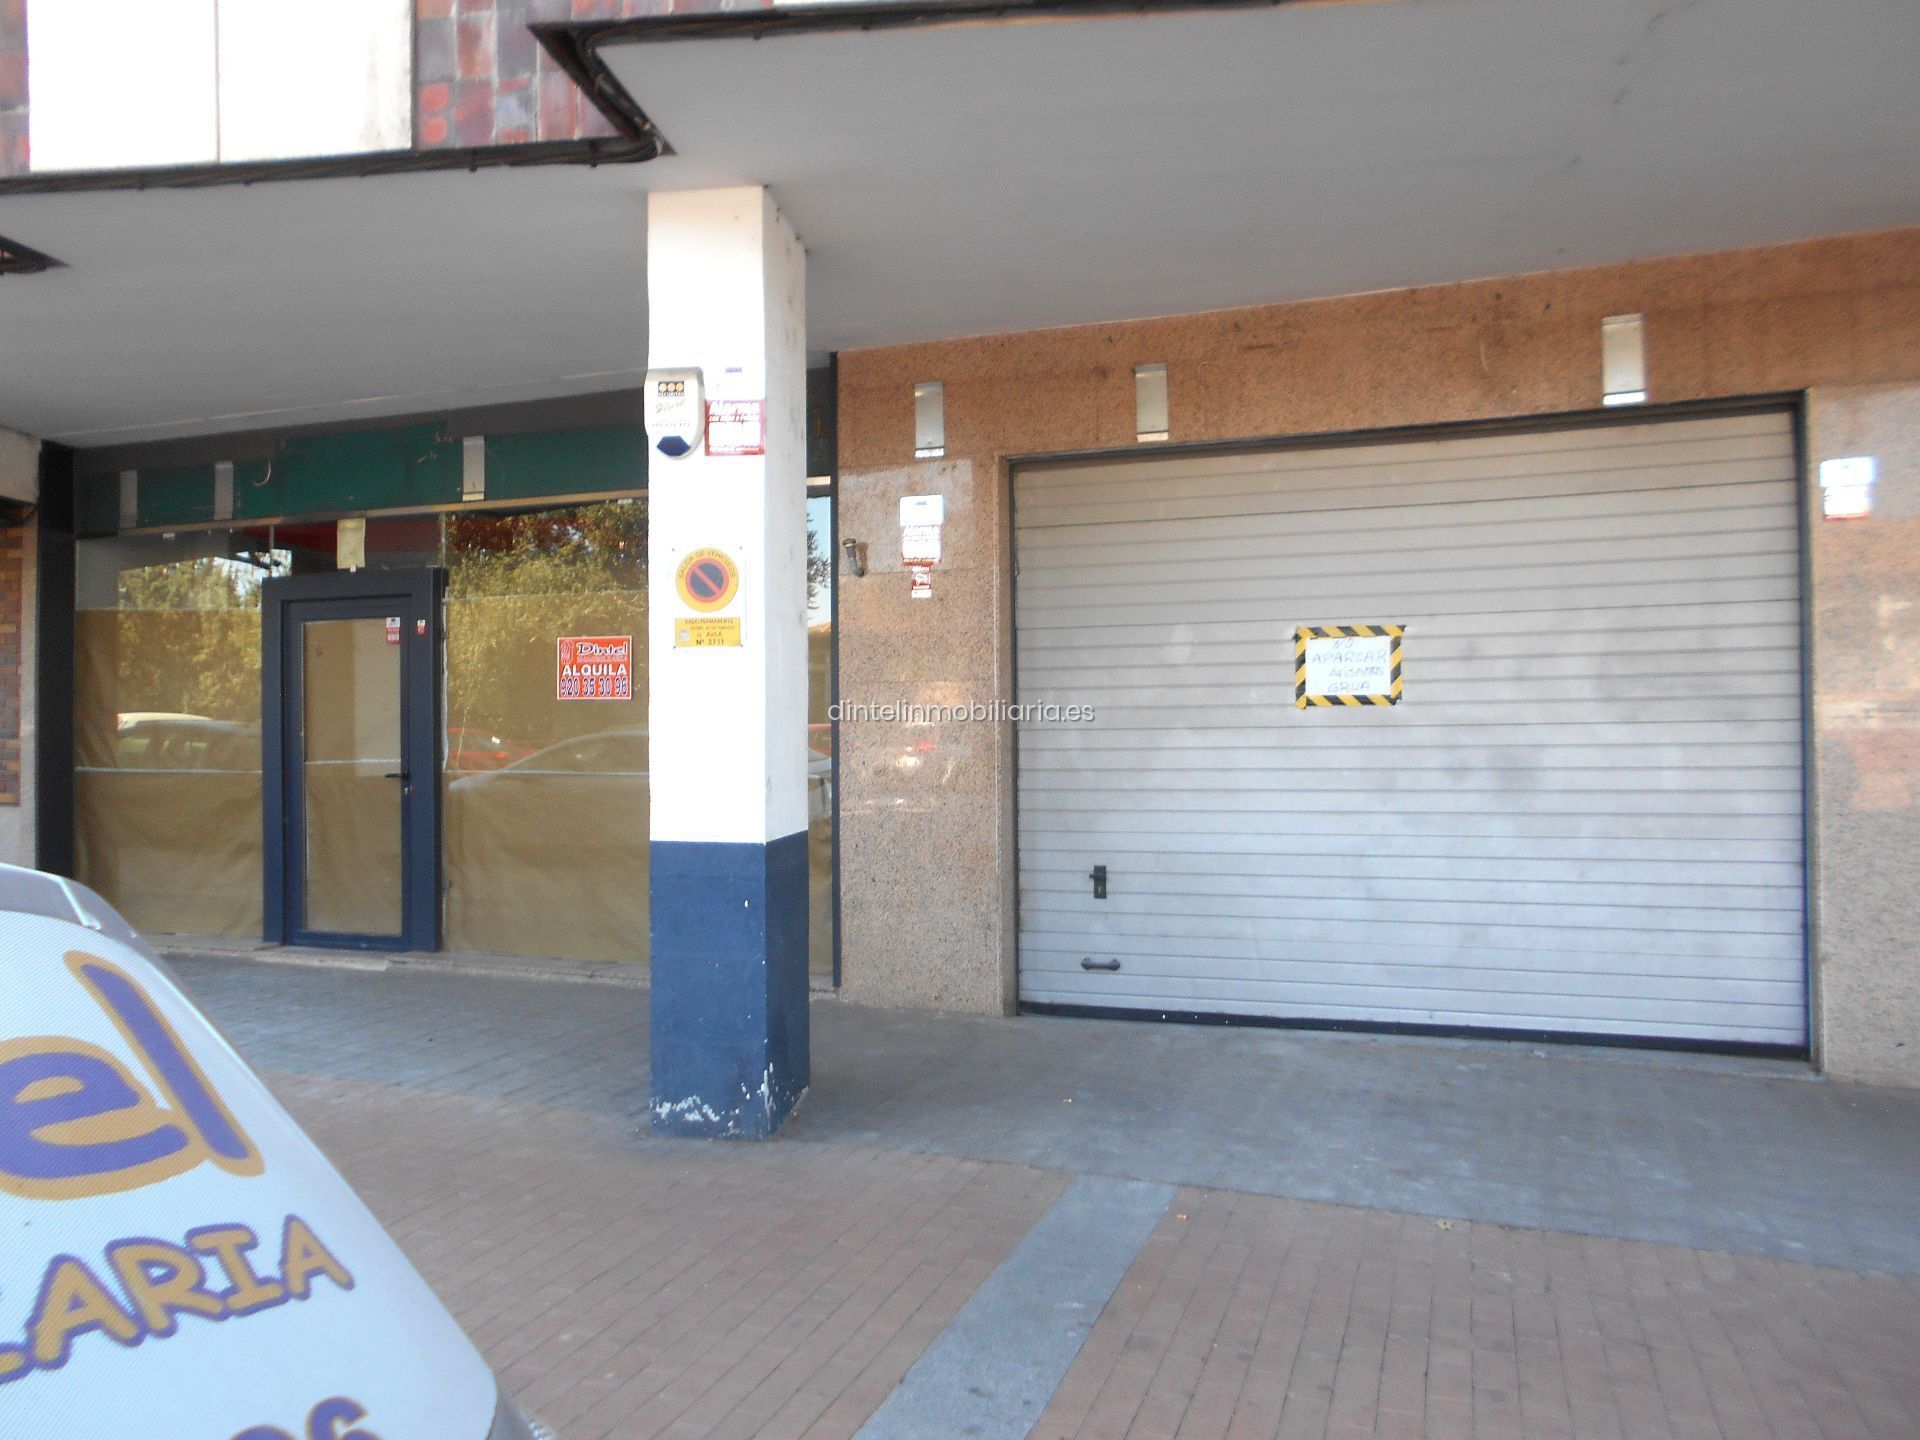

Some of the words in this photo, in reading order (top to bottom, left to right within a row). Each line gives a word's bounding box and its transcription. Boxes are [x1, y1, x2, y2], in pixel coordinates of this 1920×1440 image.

[576, 641, 628, 655] Dintel
[1332, 638, 1354, 649] NO
[1312, 649, 1387, 664] APARCAR
[562, 663, 627, 676] ALQUILA
[561, 676, 580, 696] 920
[583, 676, 596, 696] 35
[599, 676, 612, 696] 30
[615, 676, 628, 696] 96
[1328, 680, 1370, 692] GRUA
[0, 1214, 354, 1383] ARIA
